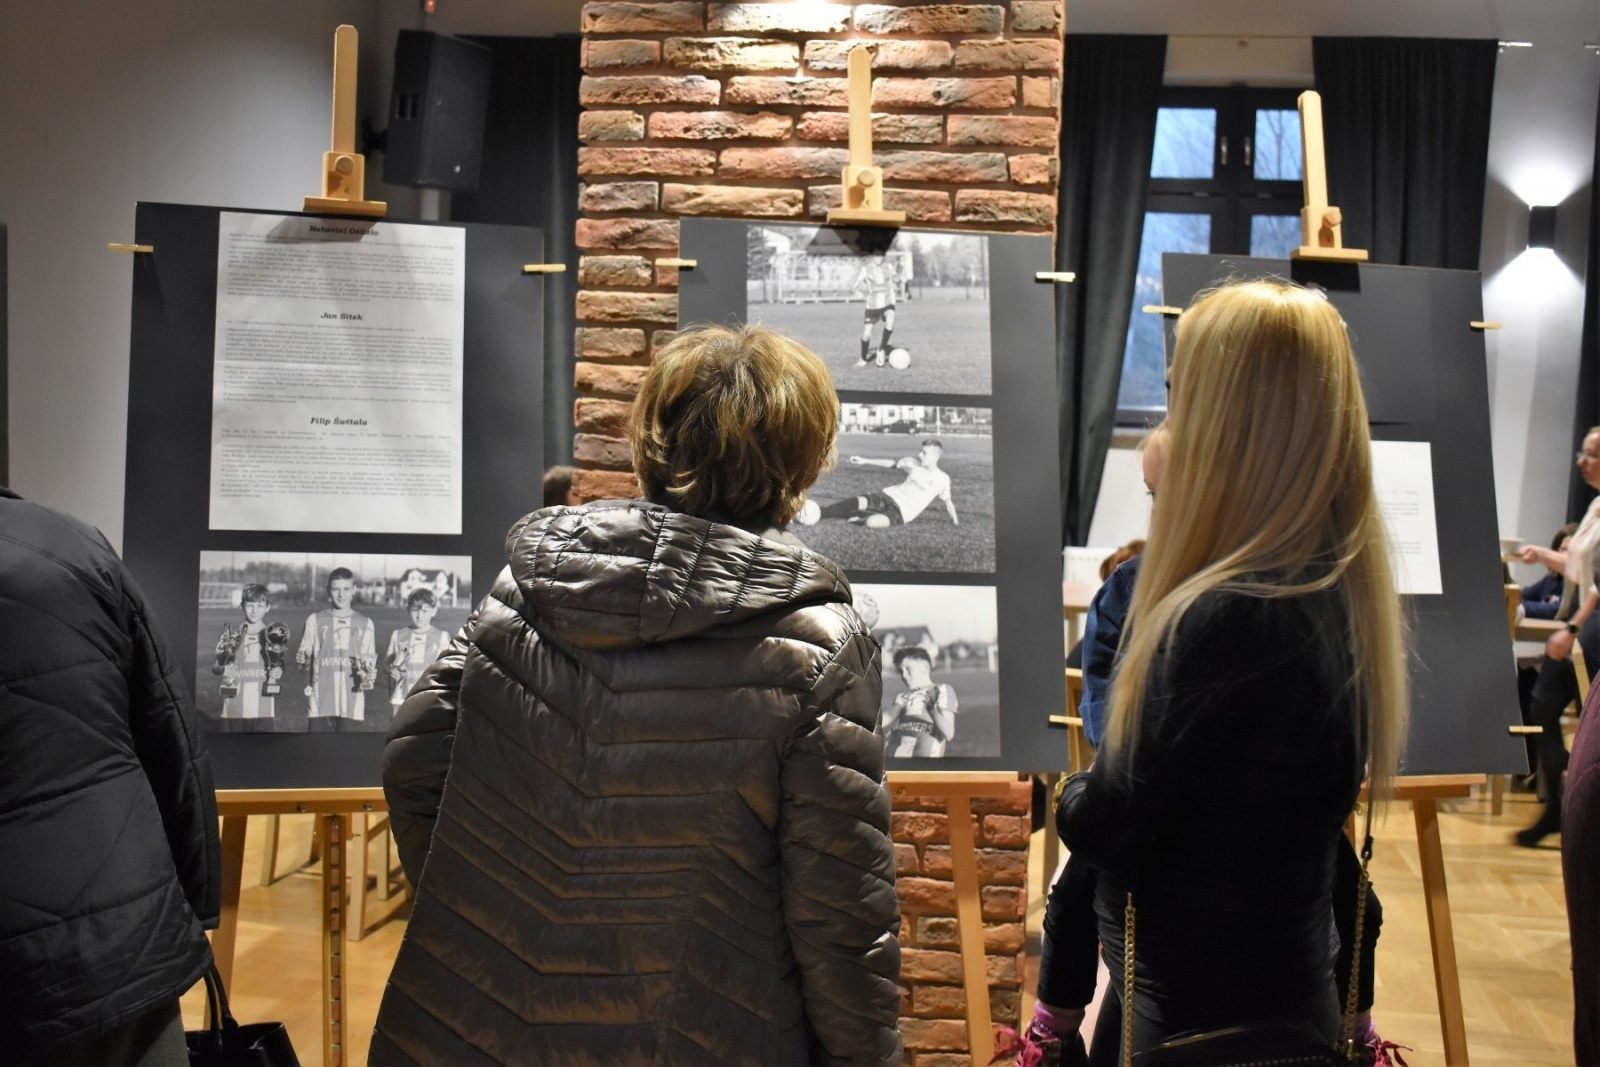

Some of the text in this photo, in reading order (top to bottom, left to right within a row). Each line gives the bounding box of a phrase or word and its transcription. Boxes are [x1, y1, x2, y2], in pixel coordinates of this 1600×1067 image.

[308, 225, 348, 235] Nataniel
[320, 312, 363, 321] Jan Sitek
[310, 417, 331, 426] Filip
[321, 625, 329, 639] 7
